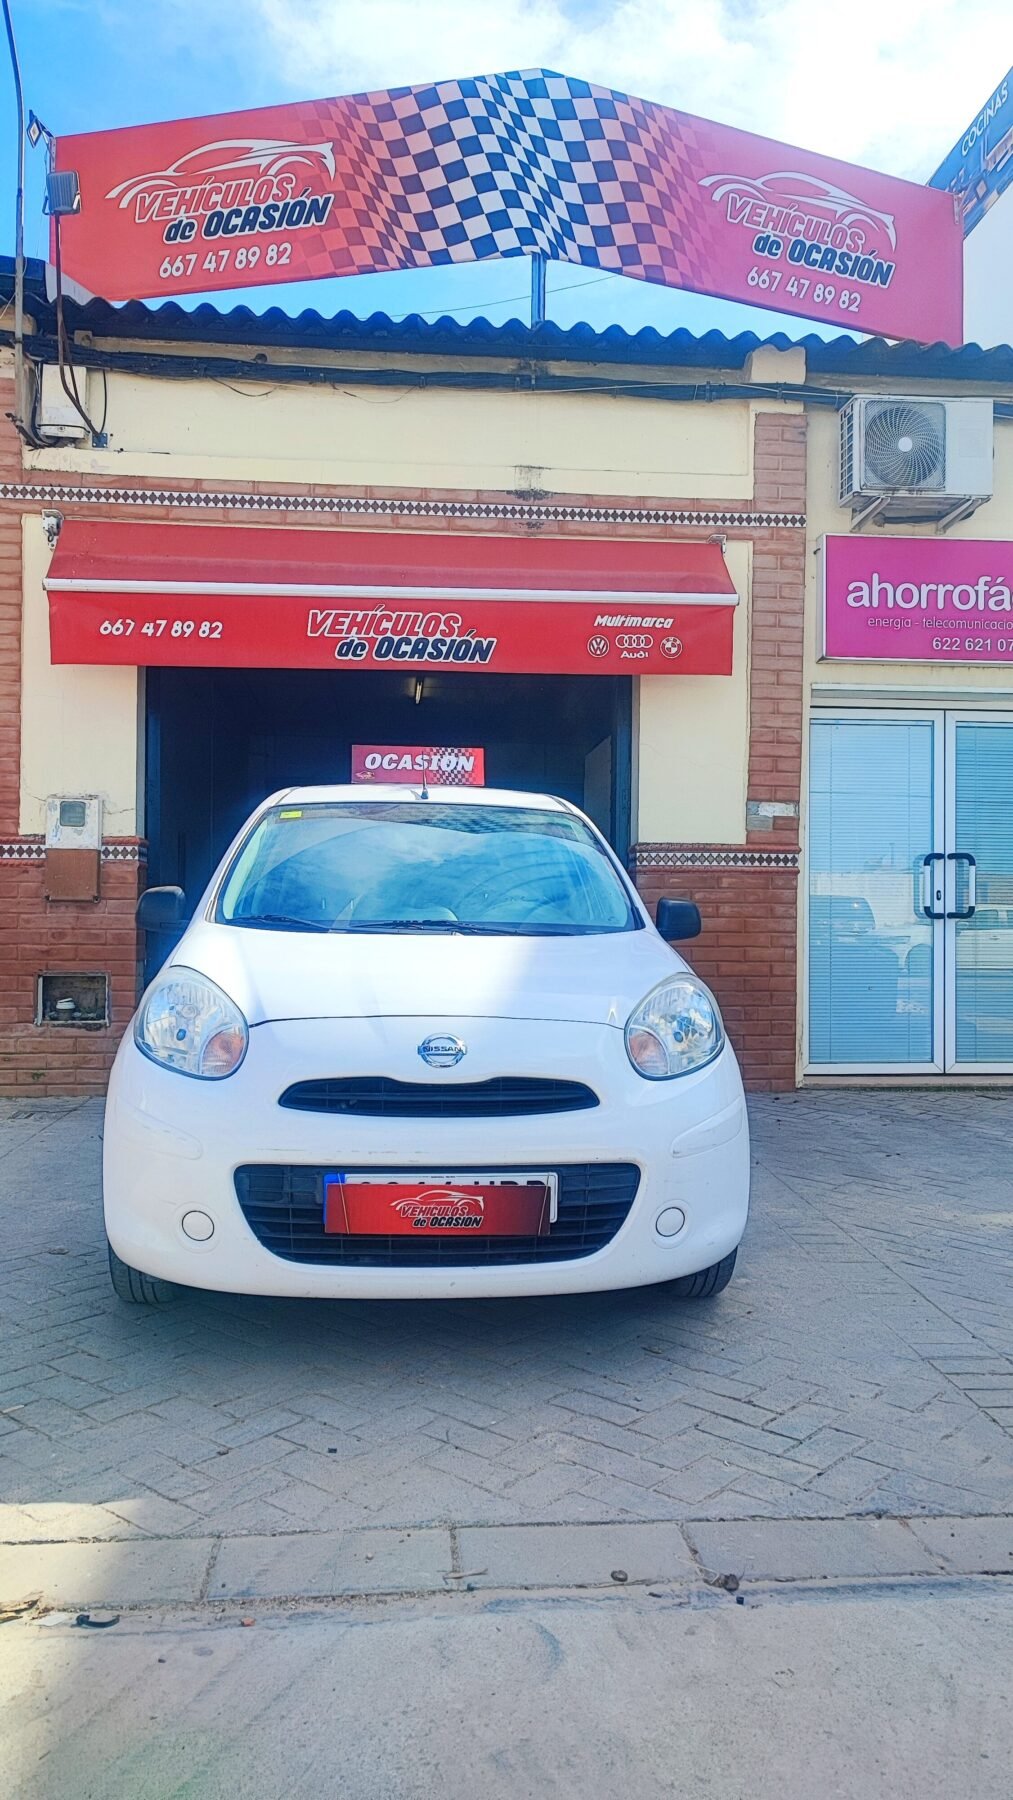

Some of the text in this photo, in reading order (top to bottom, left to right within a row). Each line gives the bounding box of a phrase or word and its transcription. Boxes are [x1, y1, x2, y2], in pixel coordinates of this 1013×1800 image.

[962, 81, 1008, 156] COCINAS
[134, 173, 296, 223] VEHÍCULOS
[163, 188, 335, 244] de OCASIÓN
[727, 192, 866, 254] VEHÍCULOS
[159, 242, 292, 278] 667 47 89 82
[752, 232, 895, 288] de OCASIÓN
[747, 267, 861, 312] 667 47 89 82
[847, 573, 1013, 612] ahorrofá
[100, 618, 223, 639] 667 47 89 82
[307, 604, 462, 638] VEHÍCULOS
[594, 614, 674, 628] Multimarca
[335, 629, 497, 664] de OCASIÓN
[621, 650, 648, 658] Audi
[932, 637, 961, 651] 622
[965, 638, 992, 652] 621
[422, 1045, 461, 1053] NISSAN
[412, 1217, 427, 1227] de
